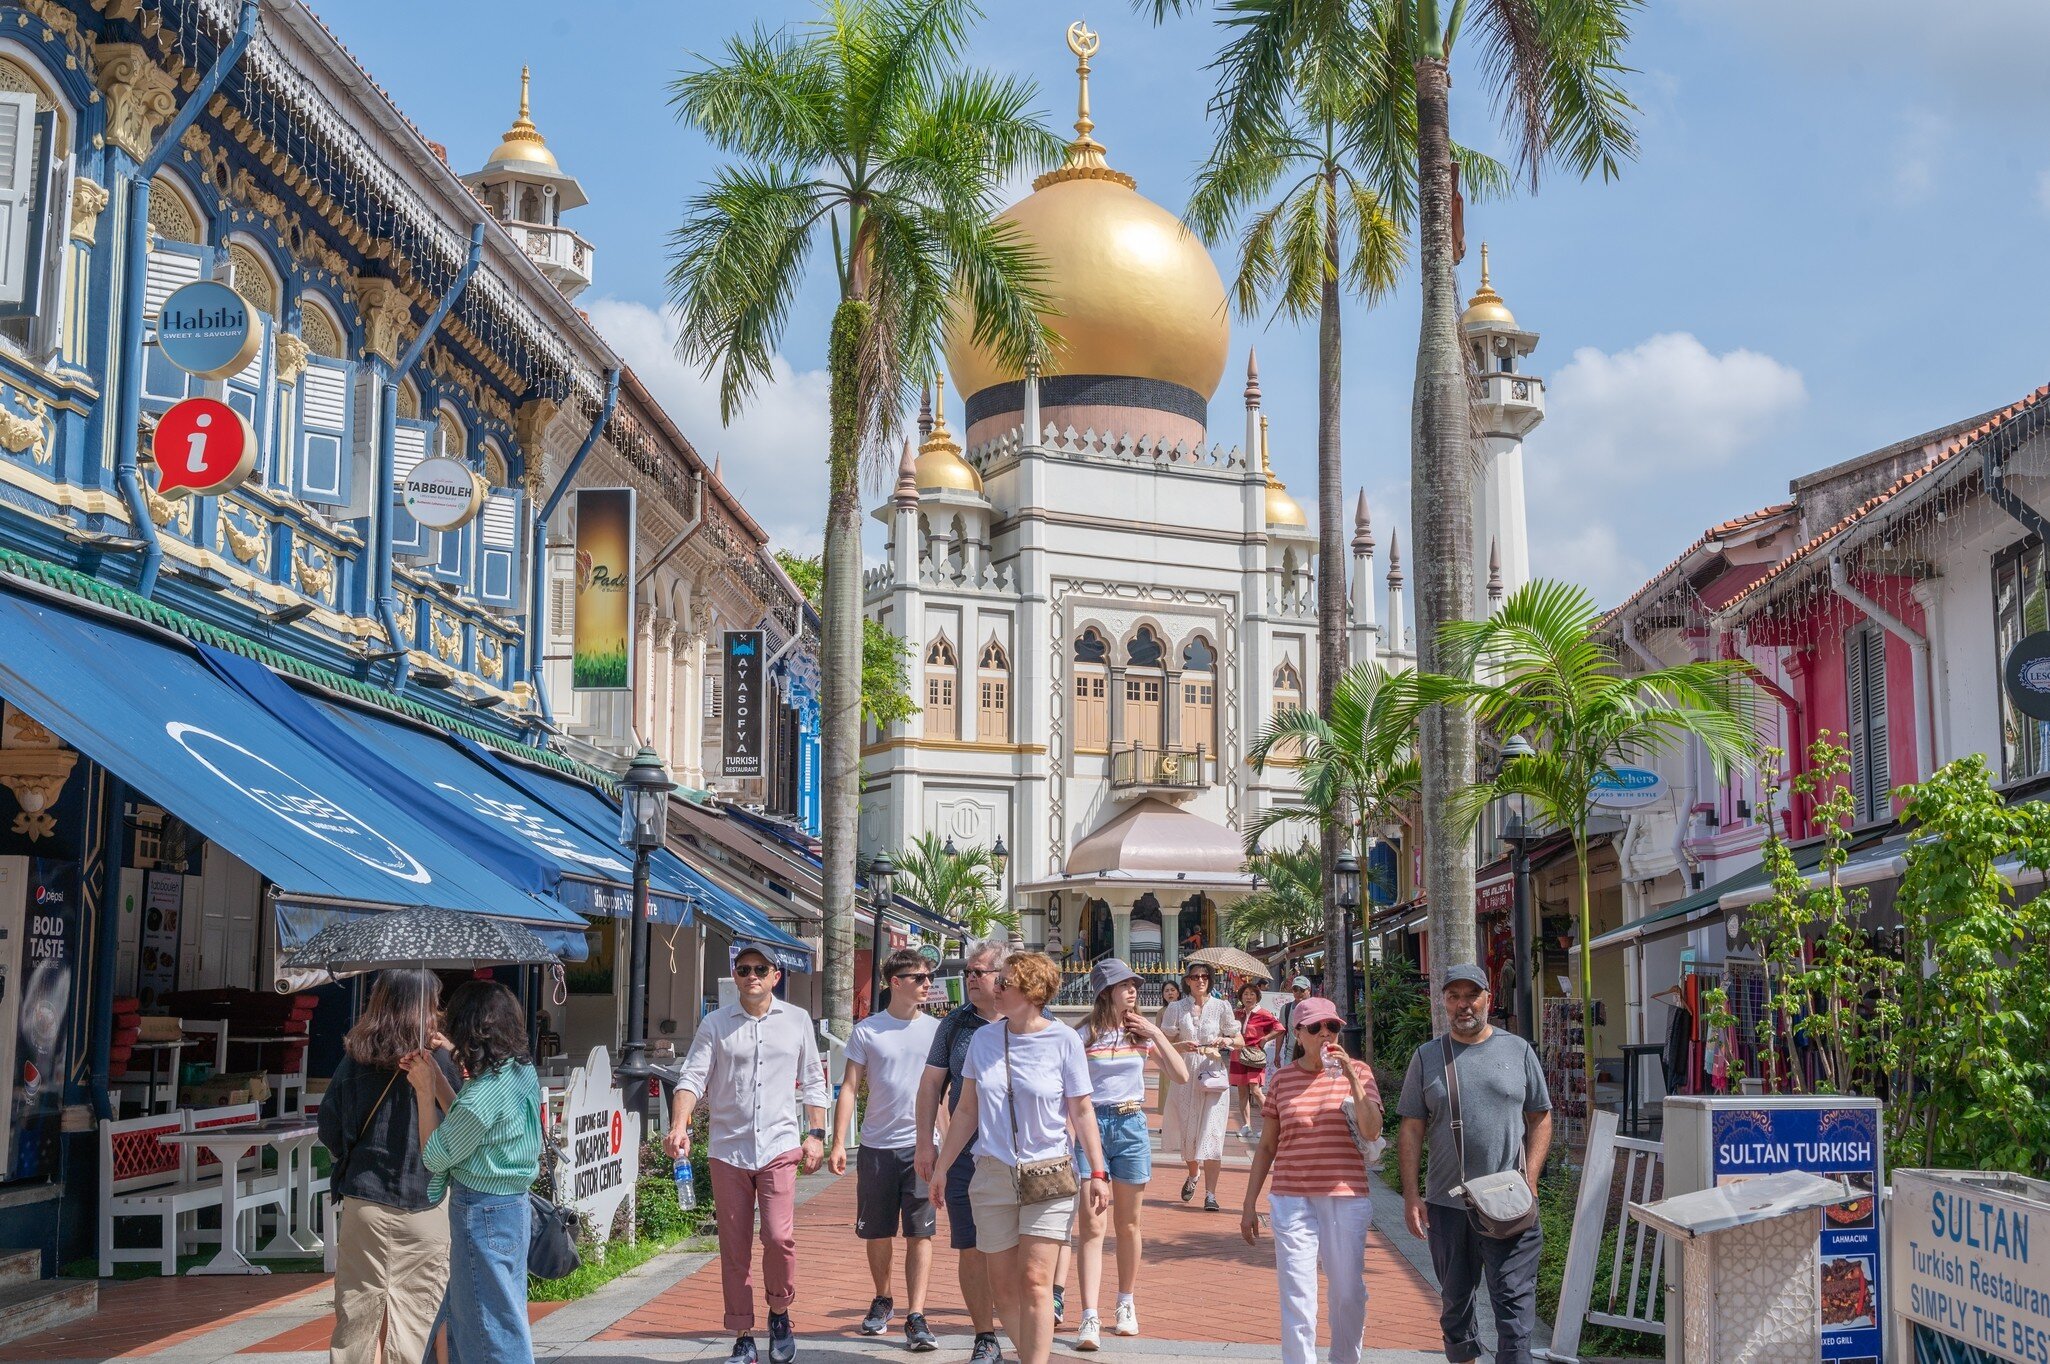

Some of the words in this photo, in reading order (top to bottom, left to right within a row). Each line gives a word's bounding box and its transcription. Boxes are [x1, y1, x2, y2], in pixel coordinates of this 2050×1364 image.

[163, 307, 243, 330] Habibi
[203, 330, 243, 338] SAVOURY
[408, 481, 472, 497] TABBOULEH
[737, 658, 748, 753] AYASOFYA
[725, 756, 758, 765] TURKISH
[46, 889, 64, 903] pepsi
[33, 915, 64, 936] BOLD
[30, 937, 65, 959] TASTE
[575, 1131, 609, 1168] SINGAPORE
[1719, 1143, 1789, 1165] SULTAN
[1793, 1142, 1871, 1163] TURKISH
[574, 1166, 598, 1200] VISITOR
[600, 1158, 622, 1192] CENTRE
[1931, 1191, 2028, 1264] SULTAN
[1832, 1235, 1868, 1244] LAHMACUN
[1910, 1241, 1964, 1287] Turkish
[1970, 1260, 2050, 1319] Restauran
[1911, 1283, 1968, 1332] SIMPLY
[1973, 1305, 2007, 1349] THE
[2012, 1320, 2050, 1364] BES
[1821, 1337, 1835, 1345] IXED
[1836, 1336, 1853, 1345] GRILL
